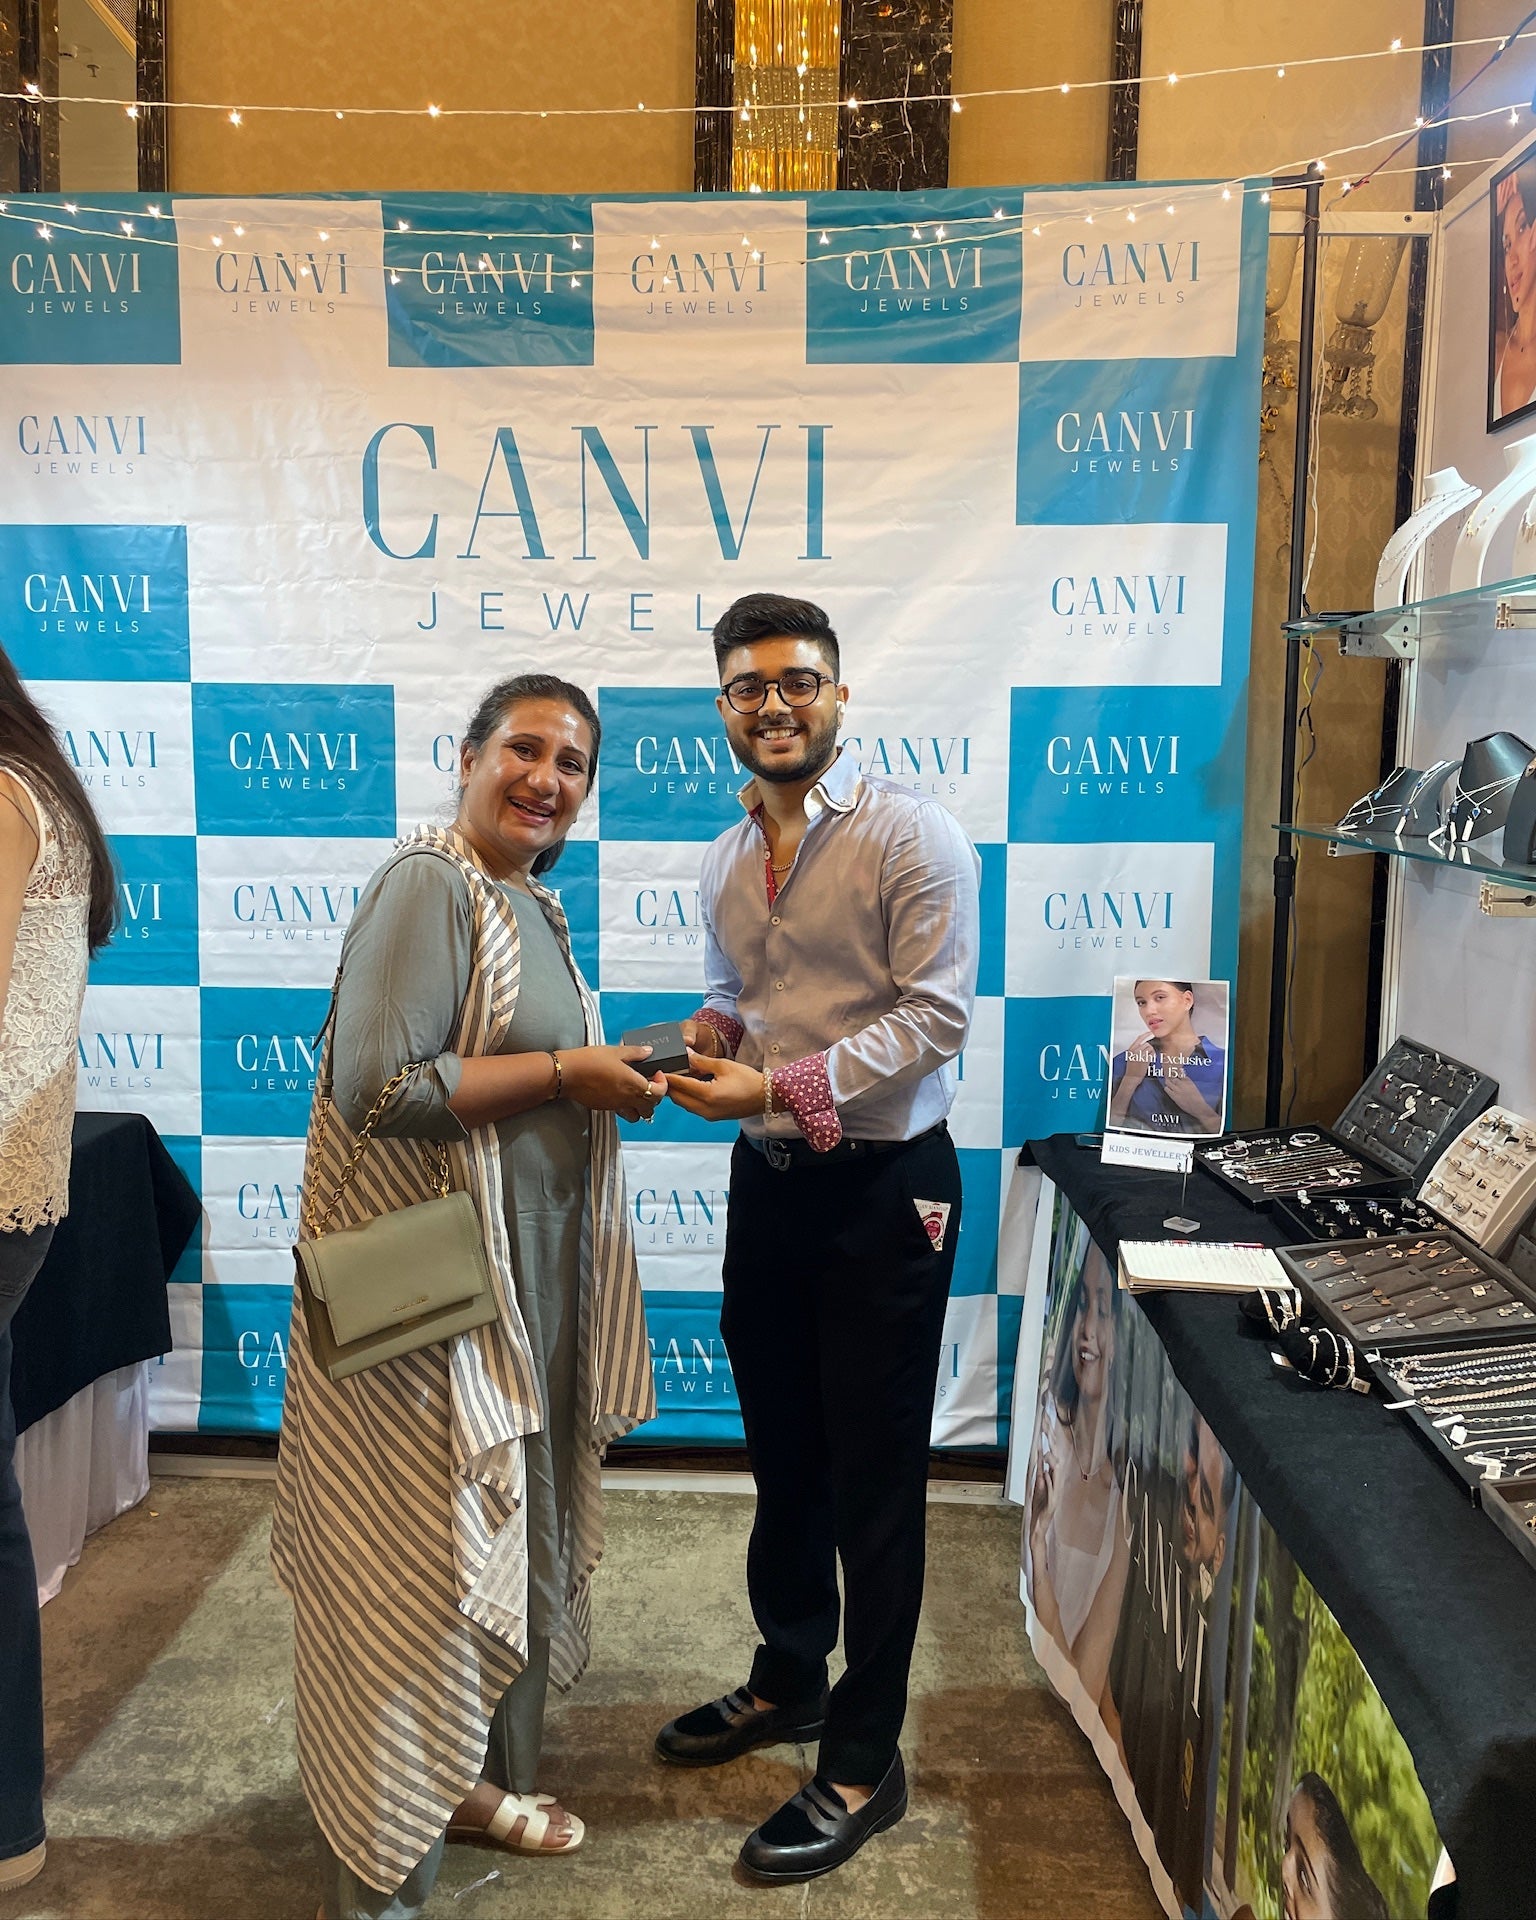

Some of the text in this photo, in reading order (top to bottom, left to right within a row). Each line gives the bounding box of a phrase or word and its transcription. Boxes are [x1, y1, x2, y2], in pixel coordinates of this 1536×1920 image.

[844, 246, 983, 292] CANVI
[1062, 241, 1200, 287] CANVI
[11, 252, 142, 294] CANVI
[215, 252, 349, 295] CANVI
[421, 251, 555, 295] CANVI
[631, 251, 767, 294] CANVI
[860, 297, 969, 312] JEWELS
[1074, 290, 1185, 307] JEWELS
[27, 300, 129, 314] JEWELS
[232, 299, 335, 315] JEWELS
[437, 300, 542, 316] JEWELS
[646, 300, 753, 315] JEWELS
[18, 415, 147, 456] CANVI
[1055, 409, 1195, 453] CANVI
[34, 462, 134, 475] JEWELS
[1071, 458, 1179, 474] JEWELS
[361, 422, 834, 560] CANVI
[23, 574, 151, 614] CANVI
[1050, 575, 1186, 616] CANVI
[417, 592, 714, 631] JEWEL
[40, 620, 140, 633] JEWELS
[1066, 621, 1171, 636] JEWELS
[62, 730, 158, 768] ANVI
[228, 732, 358, 771] CANVI
[635, 736, 745, 775] CANV
[1047, 736, 1179, 775] CANVI
[81, 775, 146, 787] WELS
[245, 776, 346, 790] JEWELS
[650, 782, 734, 794] JEWEL
[1062, 782, 1164, 795] JEWELS
[1044, 892, 1174, 930] CANVI
[650, 934, 698, 946] JEW
[1058, 936, 1159, 949] JEWELS
[78, 1033, 164, 1070] ANVI
[236, 1034, 320, 1073] CAN
[1125, 1050, 1212, 1066] Rakhi Exclusive
[1040, 1044, 1109, 1082] CAN
[1148, 1064, 1164, 1077] Flat
[88, 1076, 151, 1088] WELS
[251, 1079, 315, 1091] JEWE
[1052, 1088, 1101, 1099] JEW
[1151, 1113, 1179, 1124] CANVI
[1109, 1145, 1130, 1154] KIDS
[635, 1189, 729, 1226] CAN
[252, 1226, 299, 1238] JEW
[649, 1233, 714, 1245] JEWE
[665, 1381, 731, 1393] EWEL
[1122, 1457, 1208, 1719] CANVI
